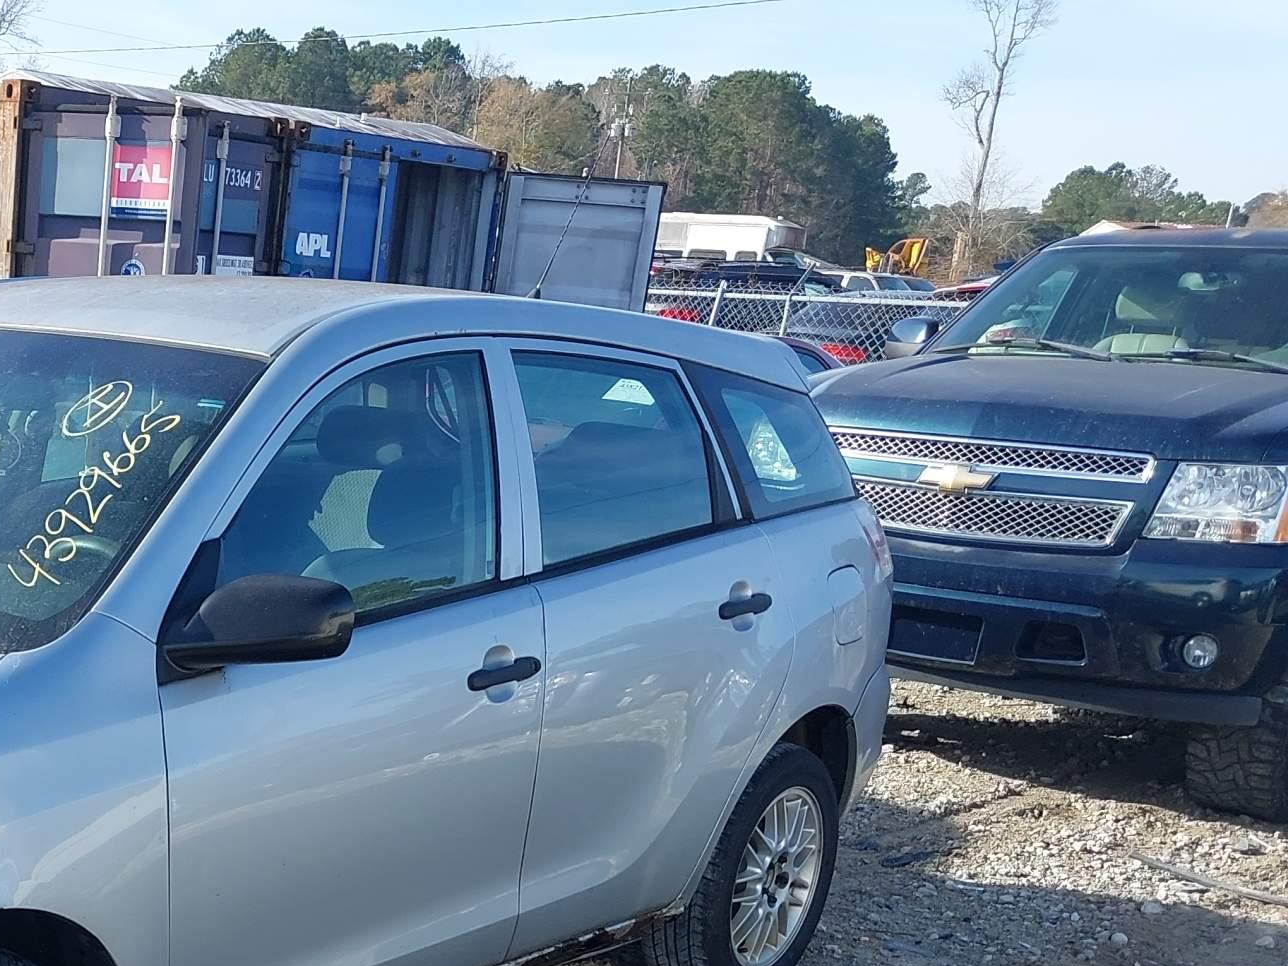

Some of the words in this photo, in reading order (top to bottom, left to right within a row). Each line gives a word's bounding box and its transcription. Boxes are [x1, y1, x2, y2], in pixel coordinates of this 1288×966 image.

[115, 162, 169, 184] TAL
[295, 232, 331, 258] APL
[8, 400, 180, 587] 43929665
